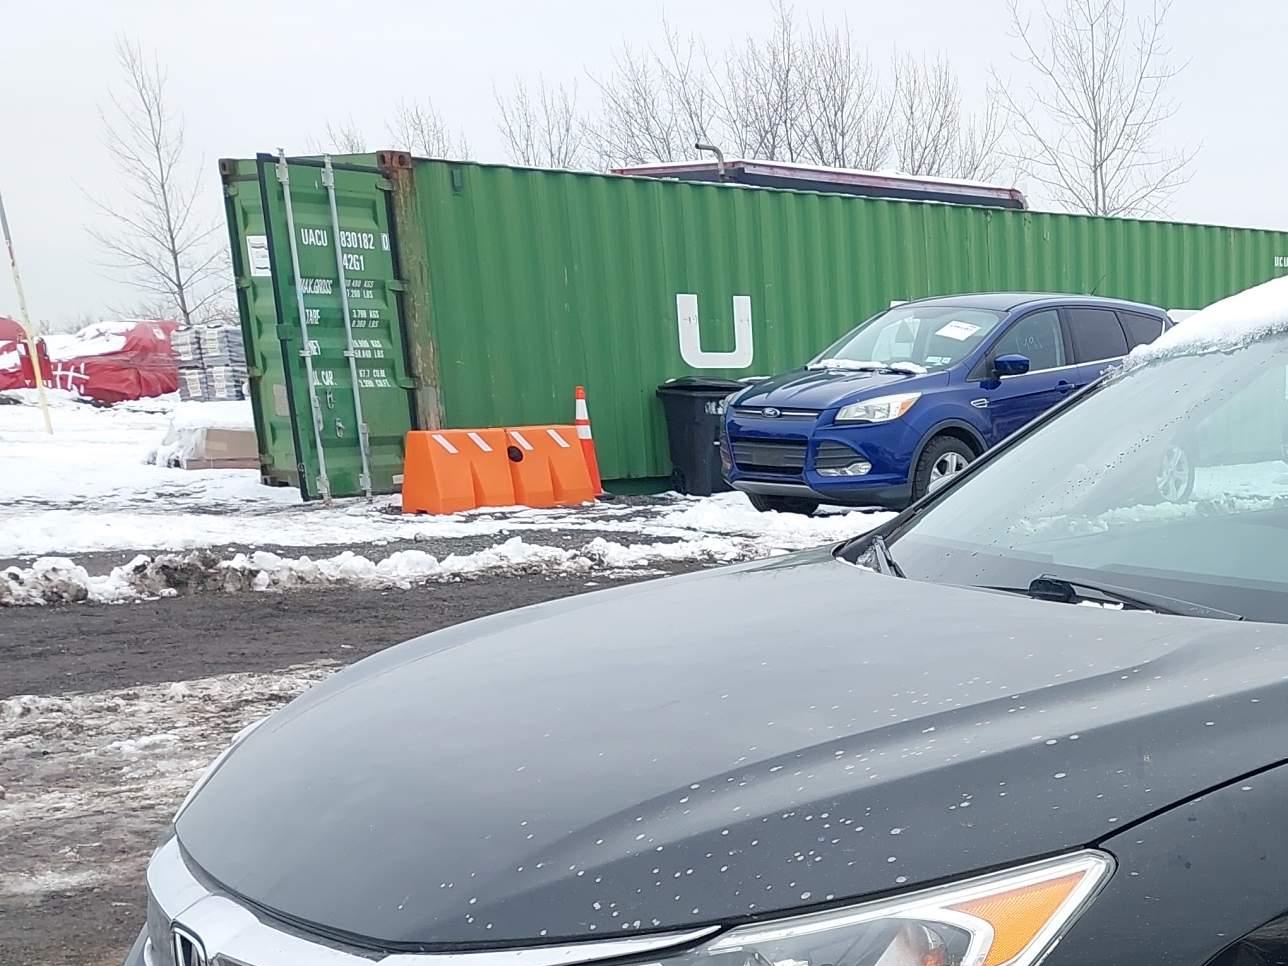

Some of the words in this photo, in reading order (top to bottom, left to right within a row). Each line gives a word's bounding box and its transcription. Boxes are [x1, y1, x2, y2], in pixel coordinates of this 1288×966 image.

[300, 228, 328, 246] UACU
[340, 231, 375, 249] 830182
[343, 253, 365, 271] 42G1
[676, 293, 753, 369] U
